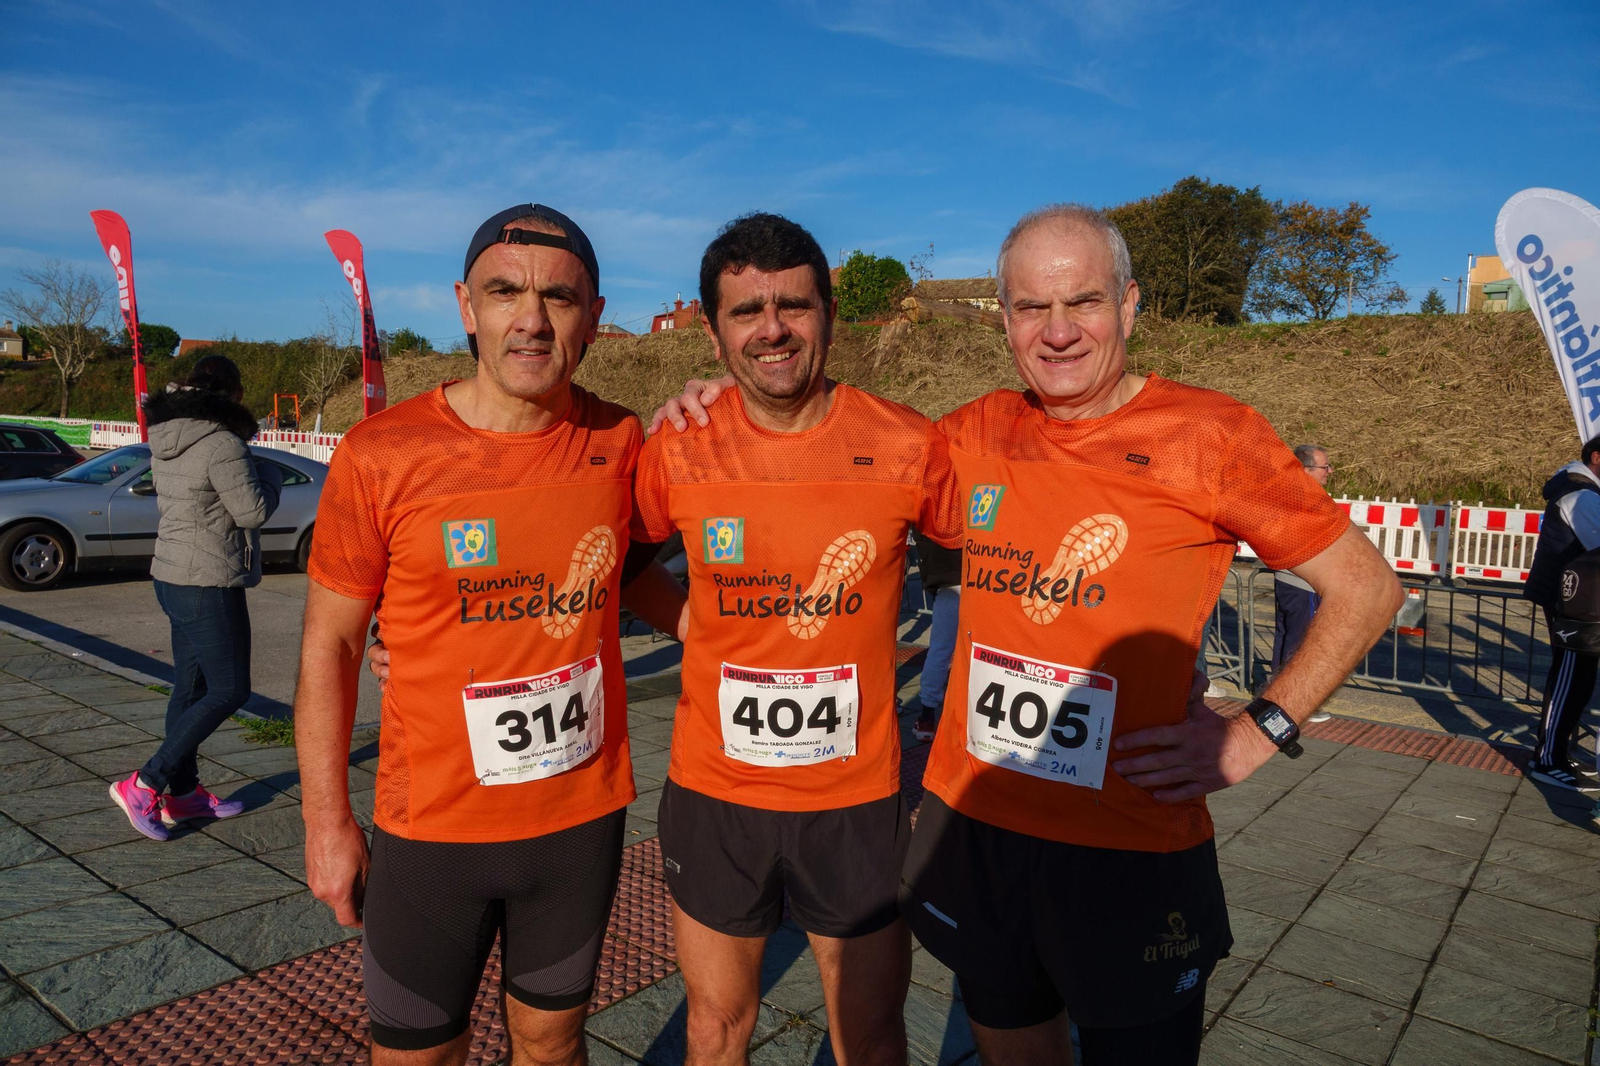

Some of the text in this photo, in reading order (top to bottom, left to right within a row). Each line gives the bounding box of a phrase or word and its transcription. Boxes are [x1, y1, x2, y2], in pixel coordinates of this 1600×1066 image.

[966, 539, 1034, 569] Running
[458, 570, 545, 594] Running
[713, 569, 792, 591] Running
[966, 558, 1105, 608] Lusekelo
[461, 577, 608, 624] Lusekelo
[718, 582, 863, 618] Lusekelo
[1004, 670, 1064, 688] MILLA CIDADE DE VIGO
[528, 690, 548, 698] CIDADE
[495, 691, 589, 752] 314
[732, 696, 841, 738] 404
[975, 681, 1091, 749] 405
[531, 747, 563, 758] VILLANUEVA
[991, 734, 1057, 756] Alberto VIDEIRA CORREA
[1095, 737, 1103, 751] 405
[1143, 933, 1201, 962] El Trigal
